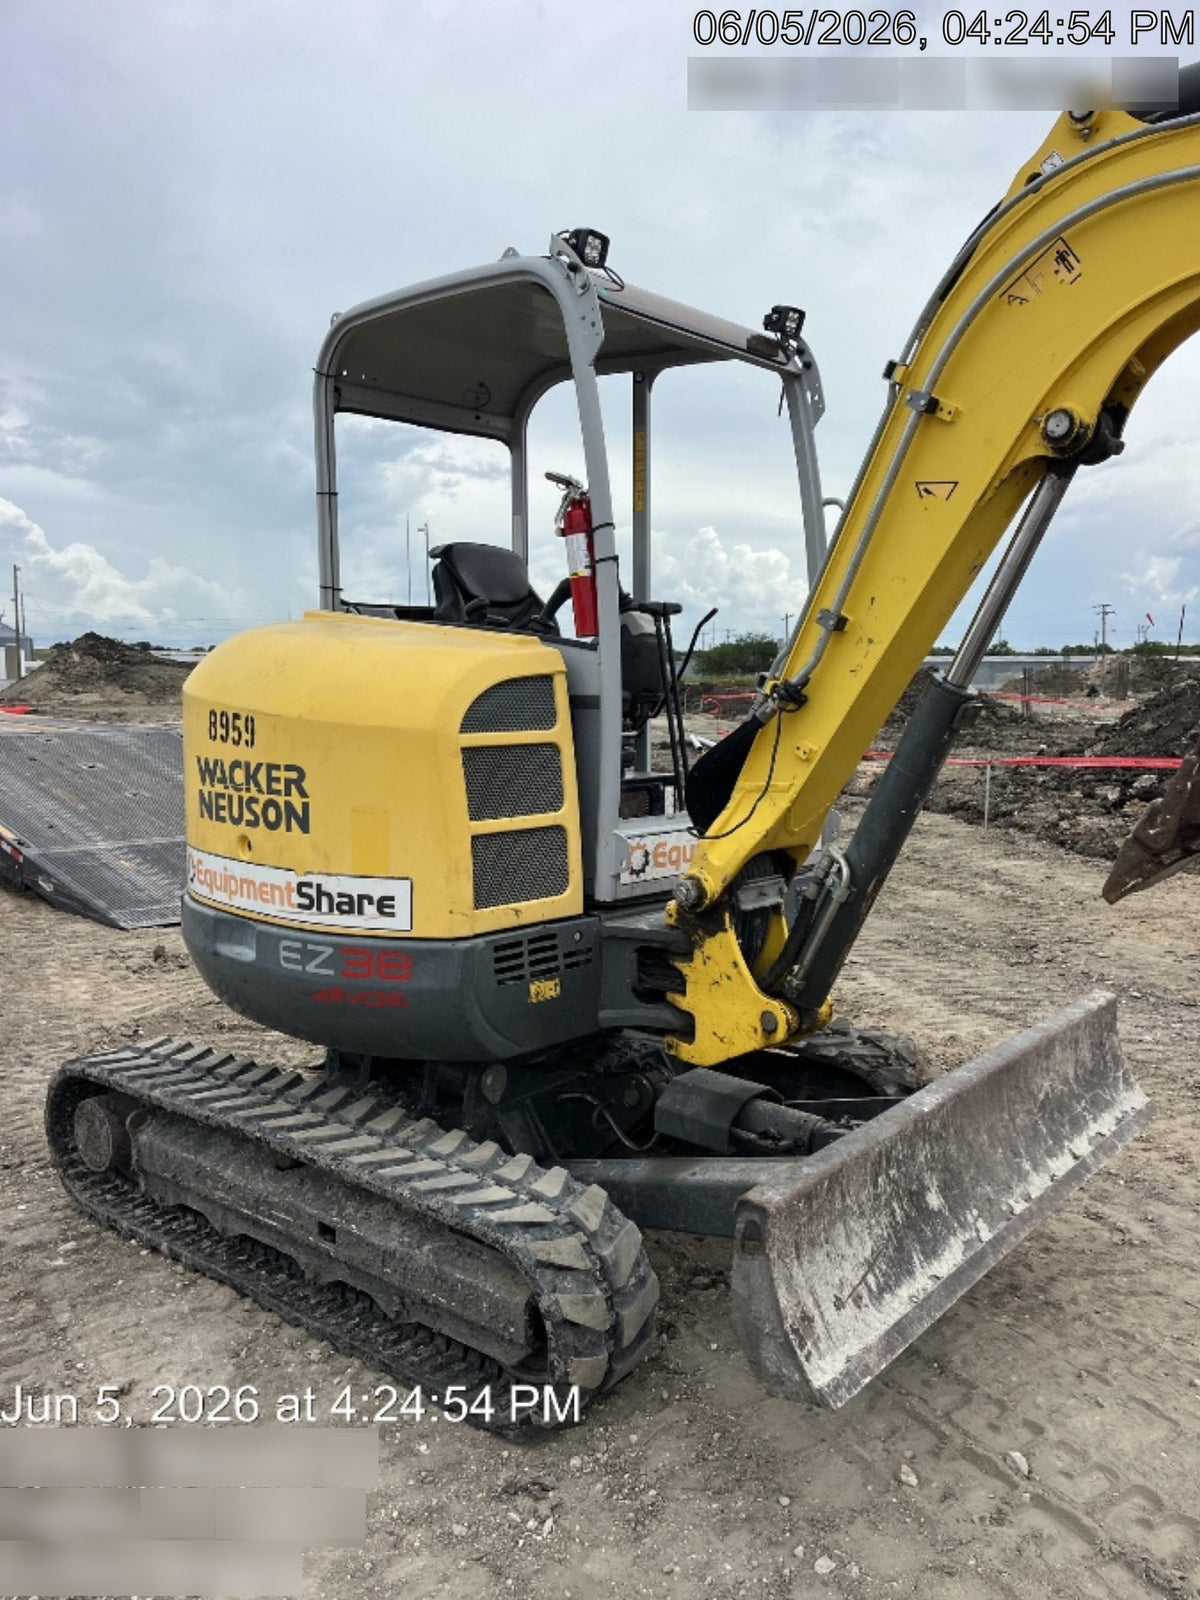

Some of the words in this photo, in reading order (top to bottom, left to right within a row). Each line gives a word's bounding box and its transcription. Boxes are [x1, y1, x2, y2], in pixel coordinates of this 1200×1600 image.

[208, 709, 256, 749] 8959
[196, 756, 310, 799] WACKER
[199, 789, 311, 834] NEUSON
[196, 858, 396, 917] EquipmentShare
[279, 940, 413, 982] EZ38
